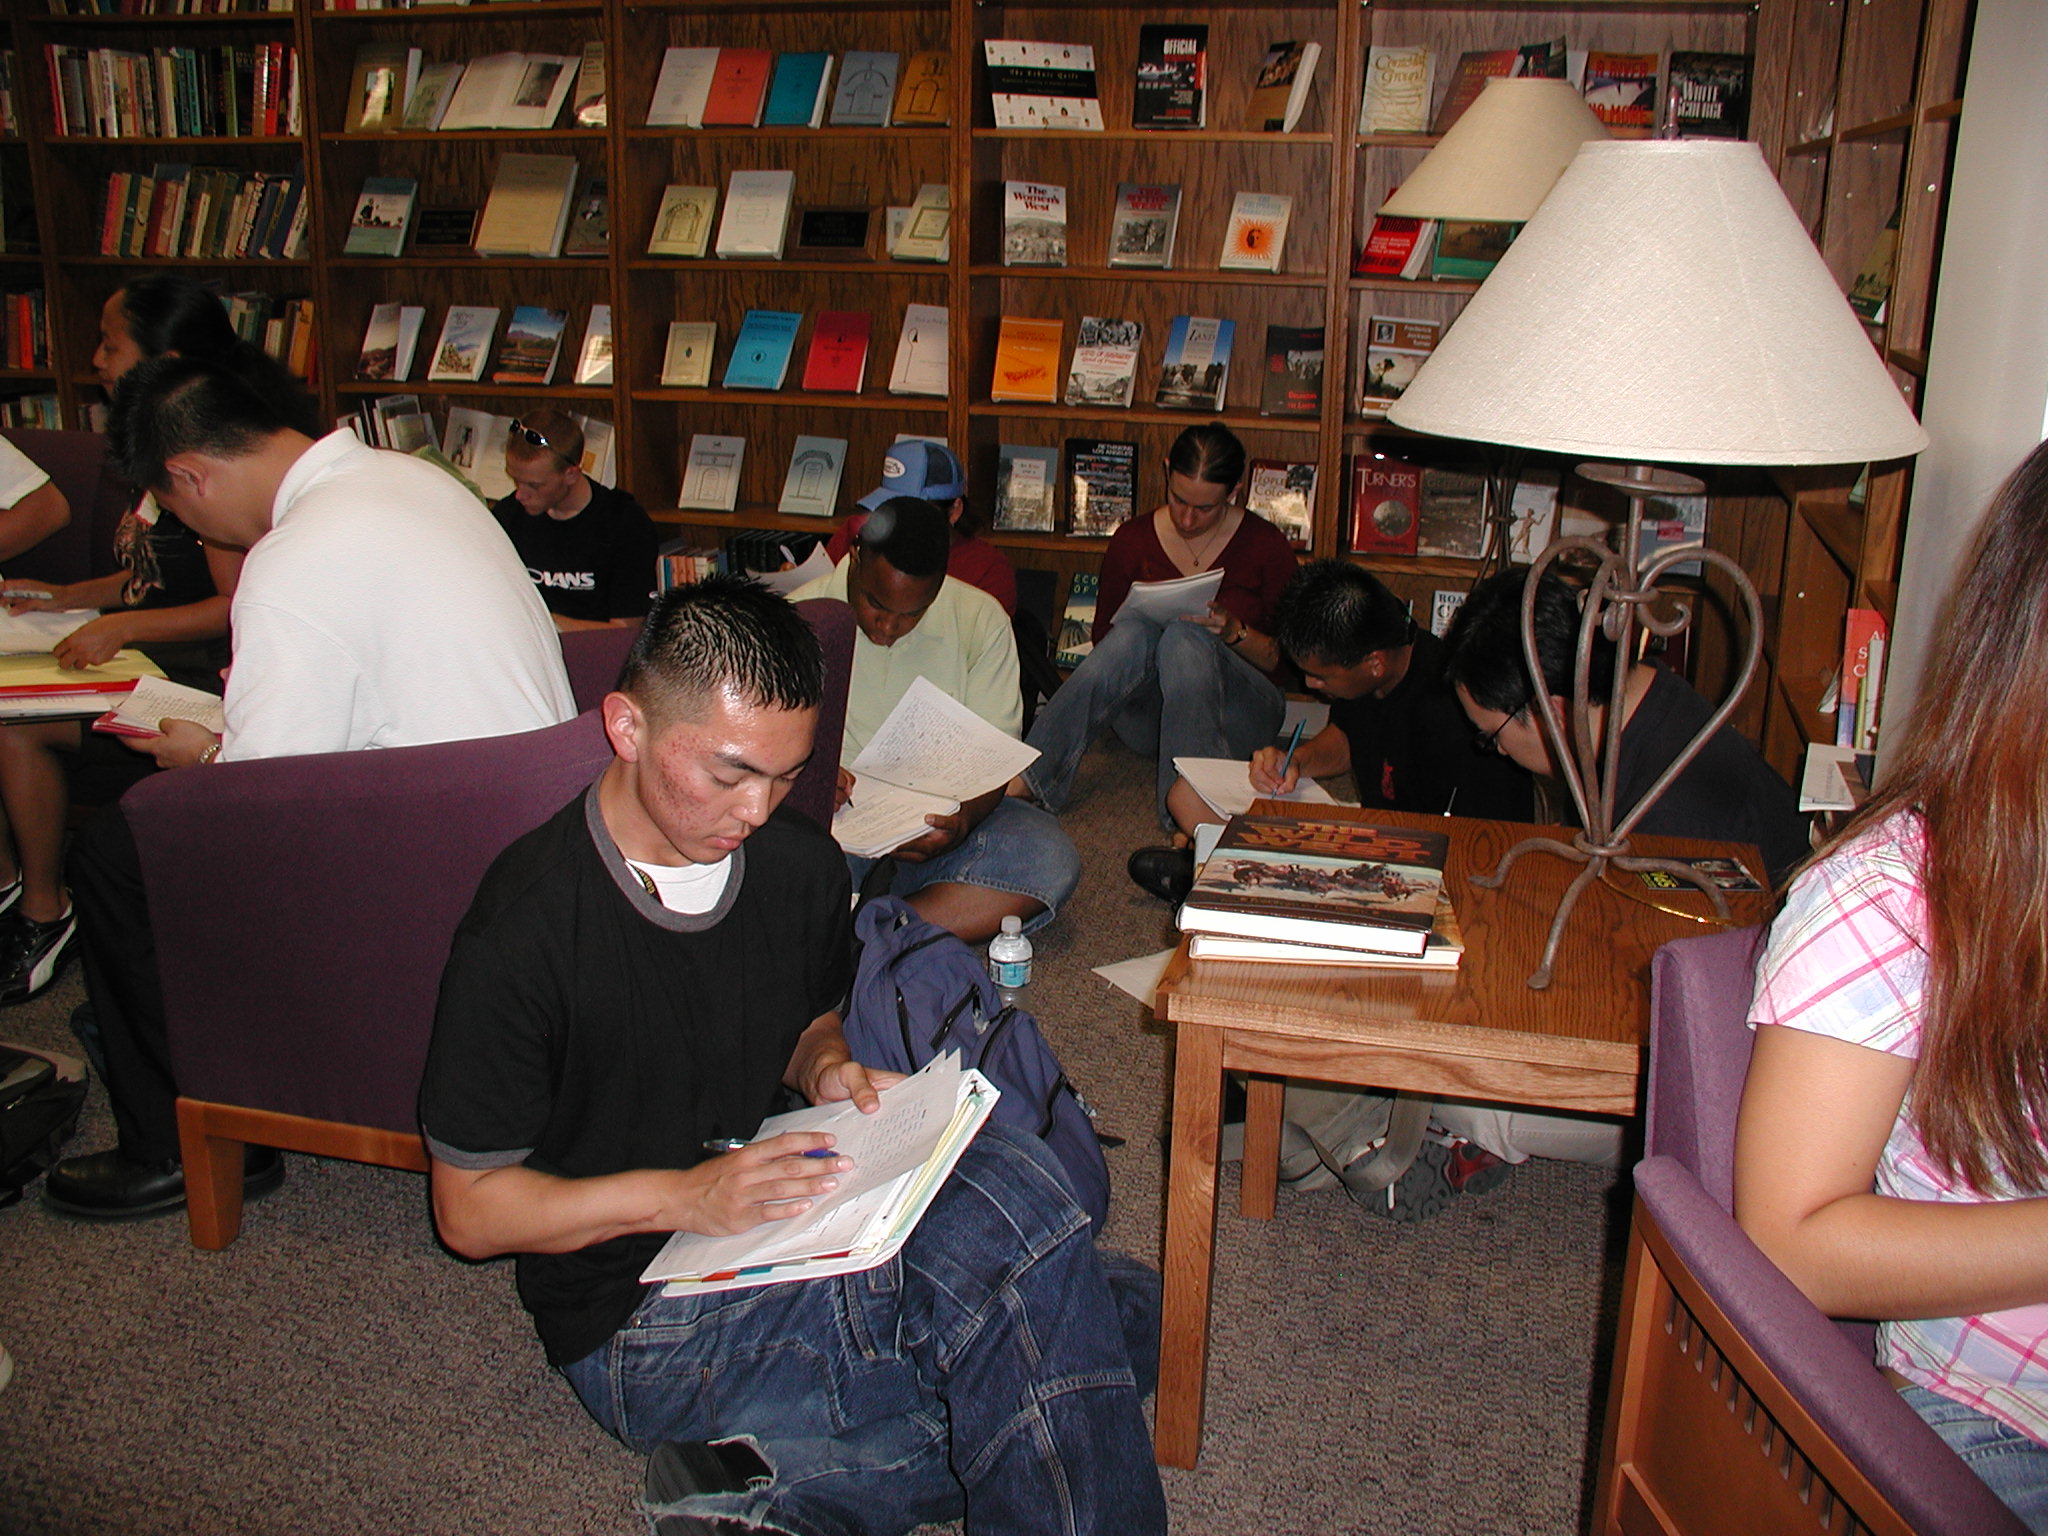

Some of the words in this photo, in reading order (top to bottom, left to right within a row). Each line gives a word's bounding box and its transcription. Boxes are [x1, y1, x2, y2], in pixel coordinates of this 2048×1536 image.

[1163, 38, 1197, 55] OFFICIAL
[1683, 80, 1719, 103] WHITE
[1610, 104, 1648, 124] MORE
[1013, 191, 1060, 205] Women's
[1025, 184, 1048, 196] The
[1024, 200, 1049, 212] West
[1356, 467, 1416, 494] TURNER'S
[1250, 826, 1422, 850] WILD
[1298, 822, 1378, 836] THE
[1236, 832, 1431, 860] WEST
